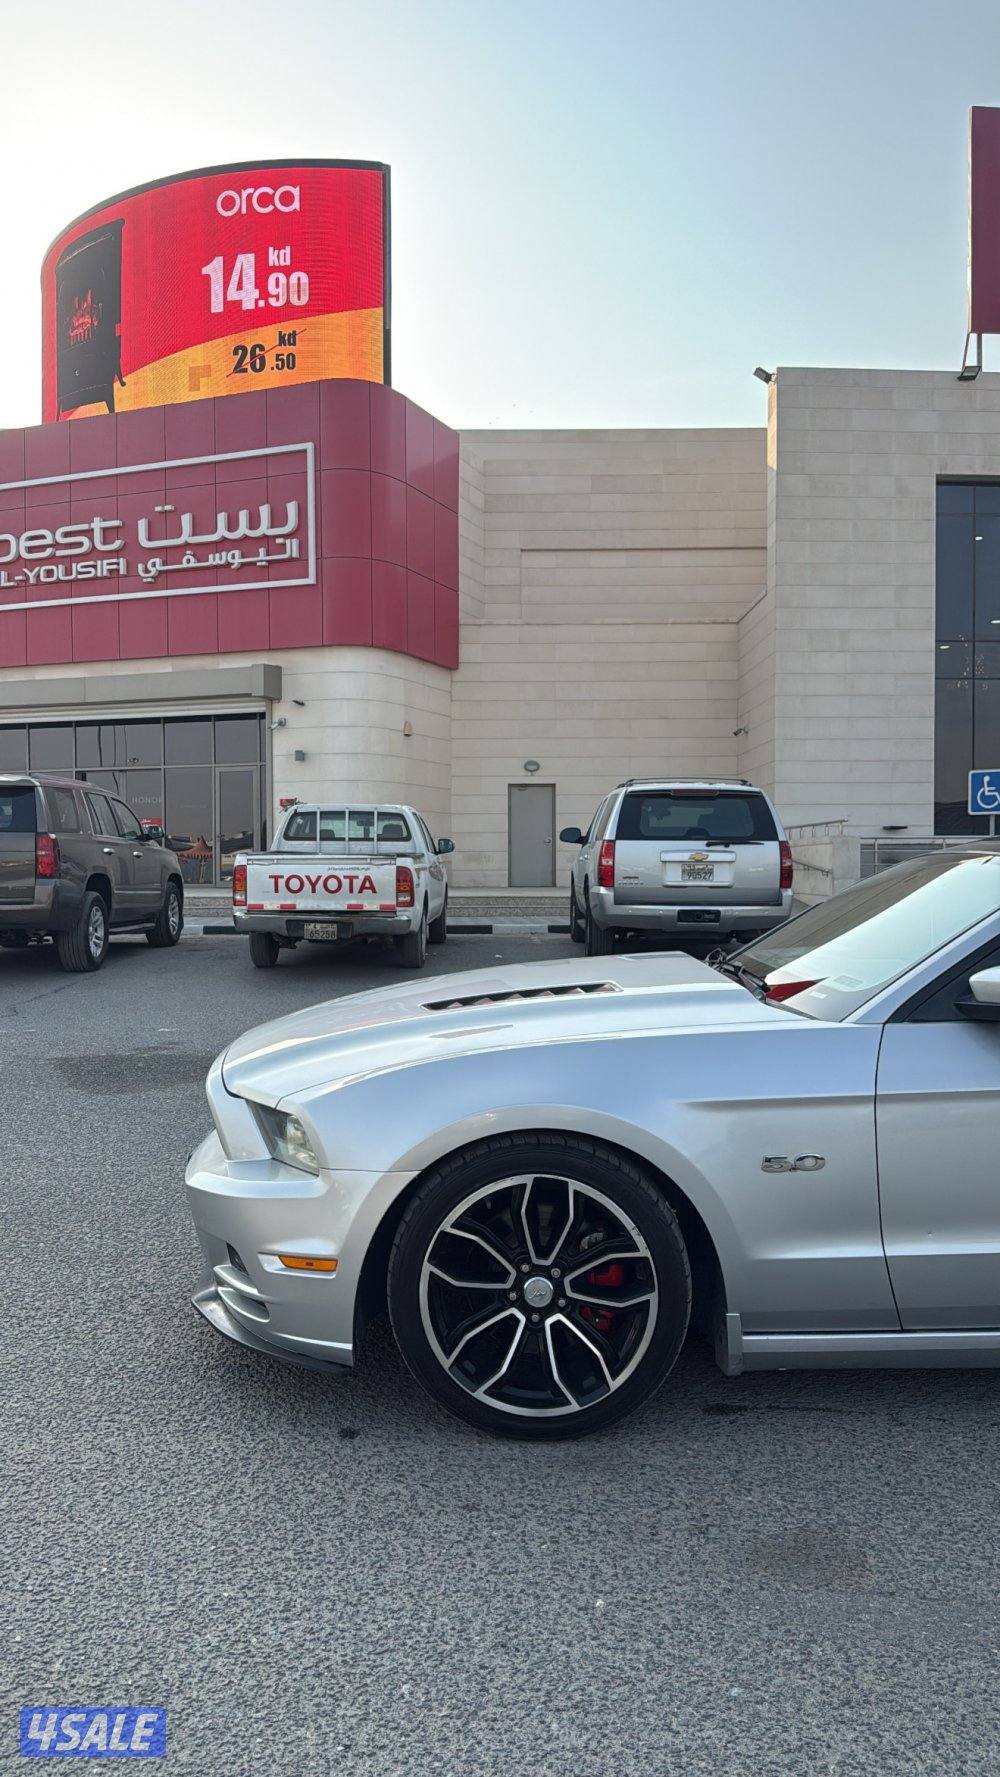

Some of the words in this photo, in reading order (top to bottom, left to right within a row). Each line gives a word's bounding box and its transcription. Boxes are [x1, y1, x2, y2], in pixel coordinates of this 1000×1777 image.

[215, 184, 301, 217] orca
[267, 246, 291, 267] kd
[201, 252, 309, 314] 14.90
[277, 330, 297, 348] kd
[231, 342, 296, 374] 26.50
[137, 500, 300, 550] بست
[137, 538, 300, 583] اليوسفي
[269, 875, 378, 894] TOYOTA
[760, 1153, 826, 1174] 5.0
